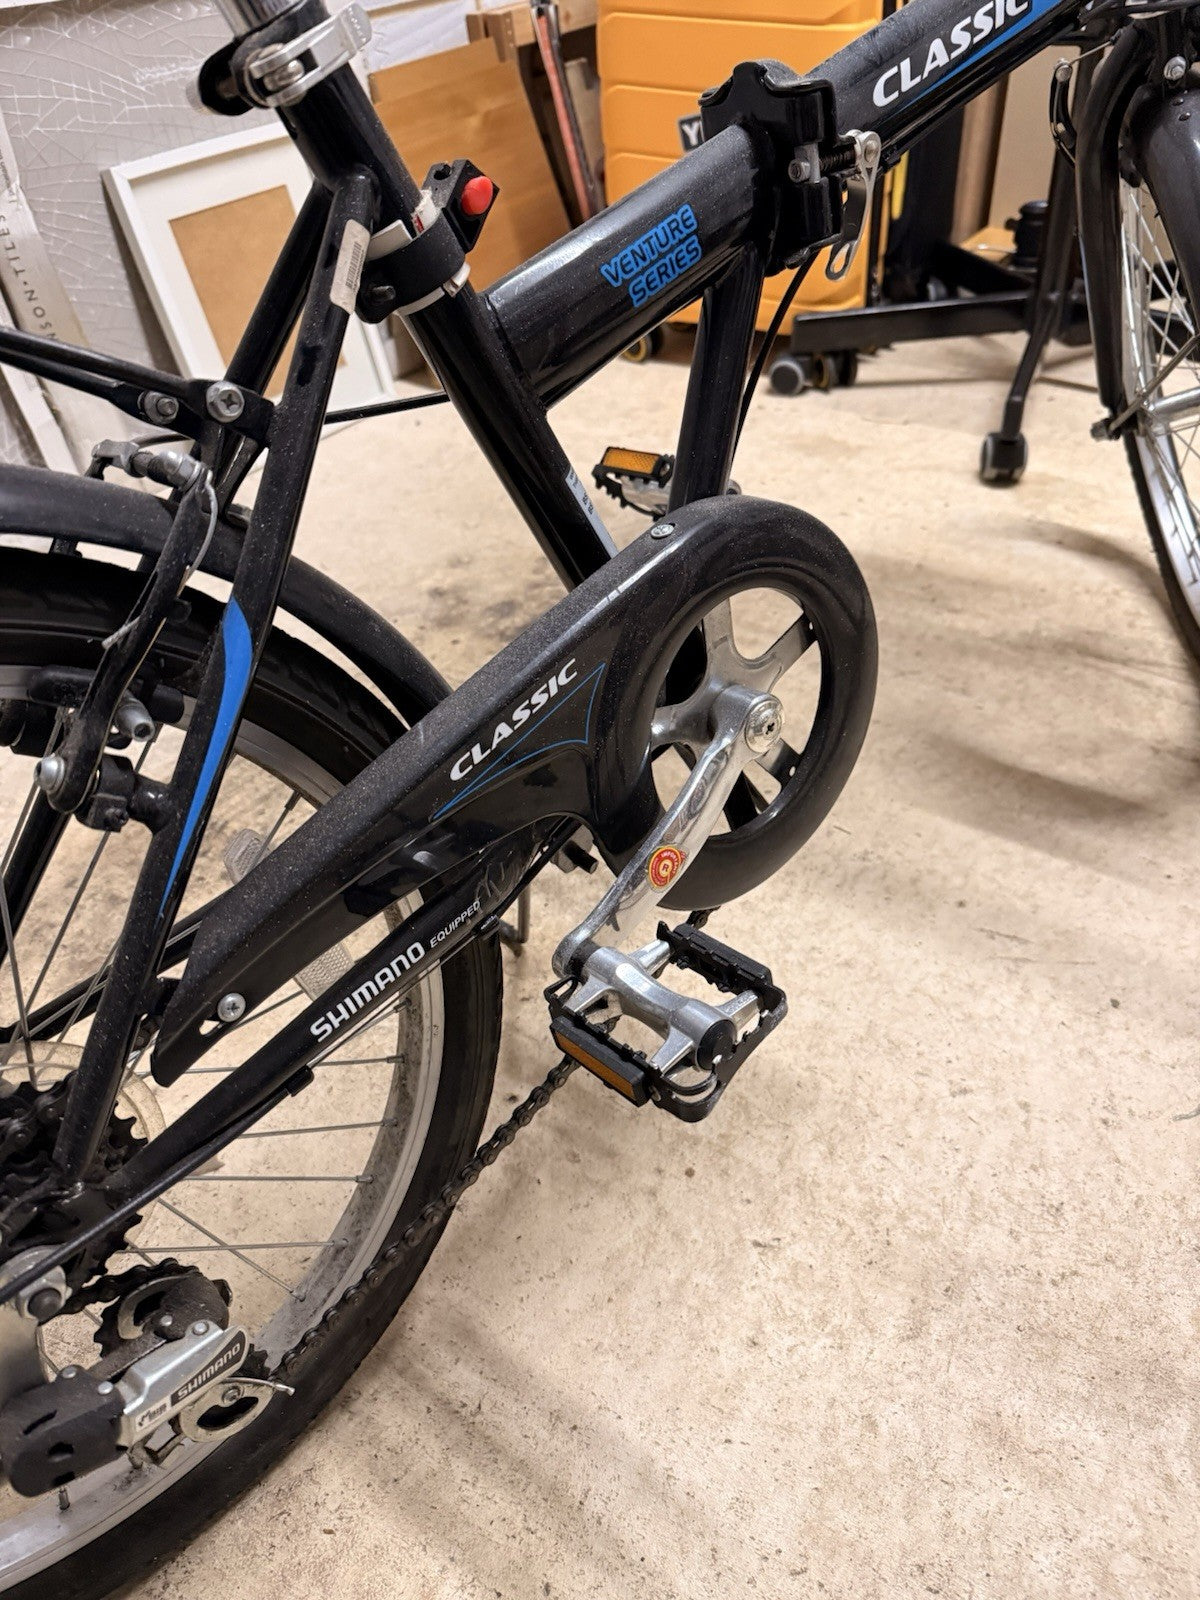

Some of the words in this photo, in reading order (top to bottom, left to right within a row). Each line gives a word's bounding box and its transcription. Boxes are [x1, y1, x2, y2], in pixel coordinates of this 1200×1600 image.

[602, 206, 696, 286] VENTURE
[629, 235, 701, 305] SERIES
[450, 658, 578, 781] CLASSIC
[310, 941, 426, 1043] SHIMANO
[429, 900, 481, 949] EQUIPPED
[178, 1343, 241, 1401] SHIMANO
